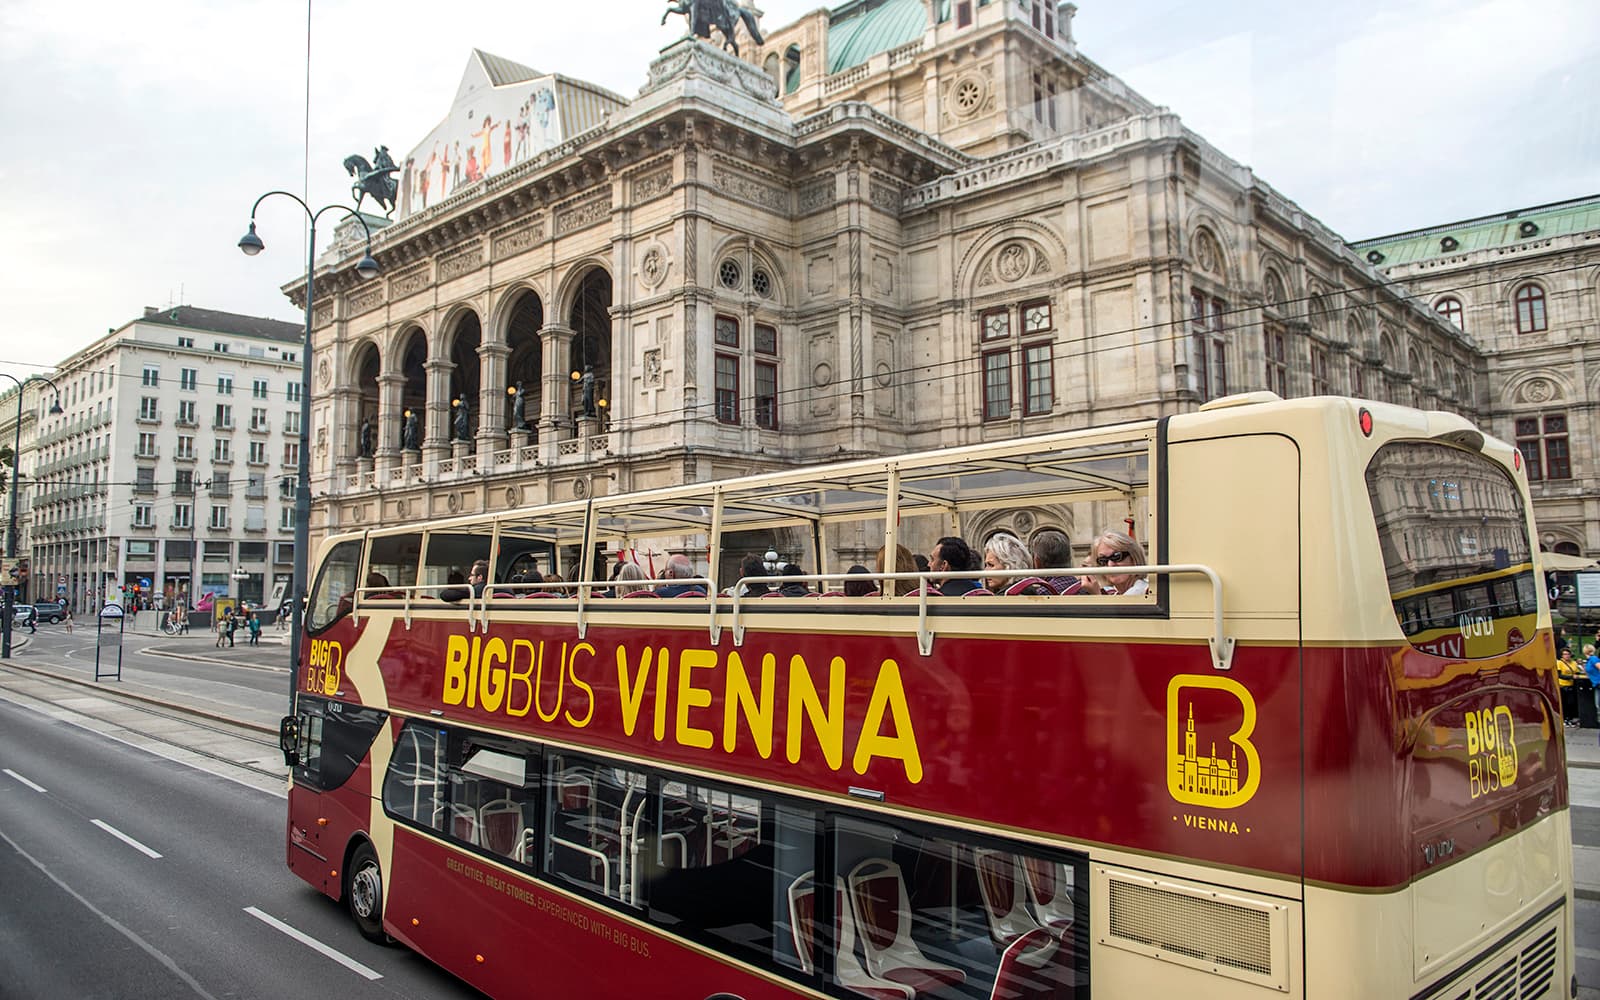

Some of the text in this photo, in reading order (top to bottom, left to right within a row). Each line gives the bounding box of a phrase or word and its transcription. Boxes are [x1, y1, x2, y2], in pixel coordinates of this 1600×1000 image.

[310, 639, 329, 667] BIG
[306, 667, 326, 694] BUS
[616, 644, 924, 784] VIENNA
[1465, 708, 1496, 756] BIG
[1469, 754, 1501, 799] BUS
[1183, 814, 1240, 835] VIENNA
[446, 857, 652, 959] GREAT CITIES. GREAT STORIES. EXPERIENCED WITH BIG BUS.
